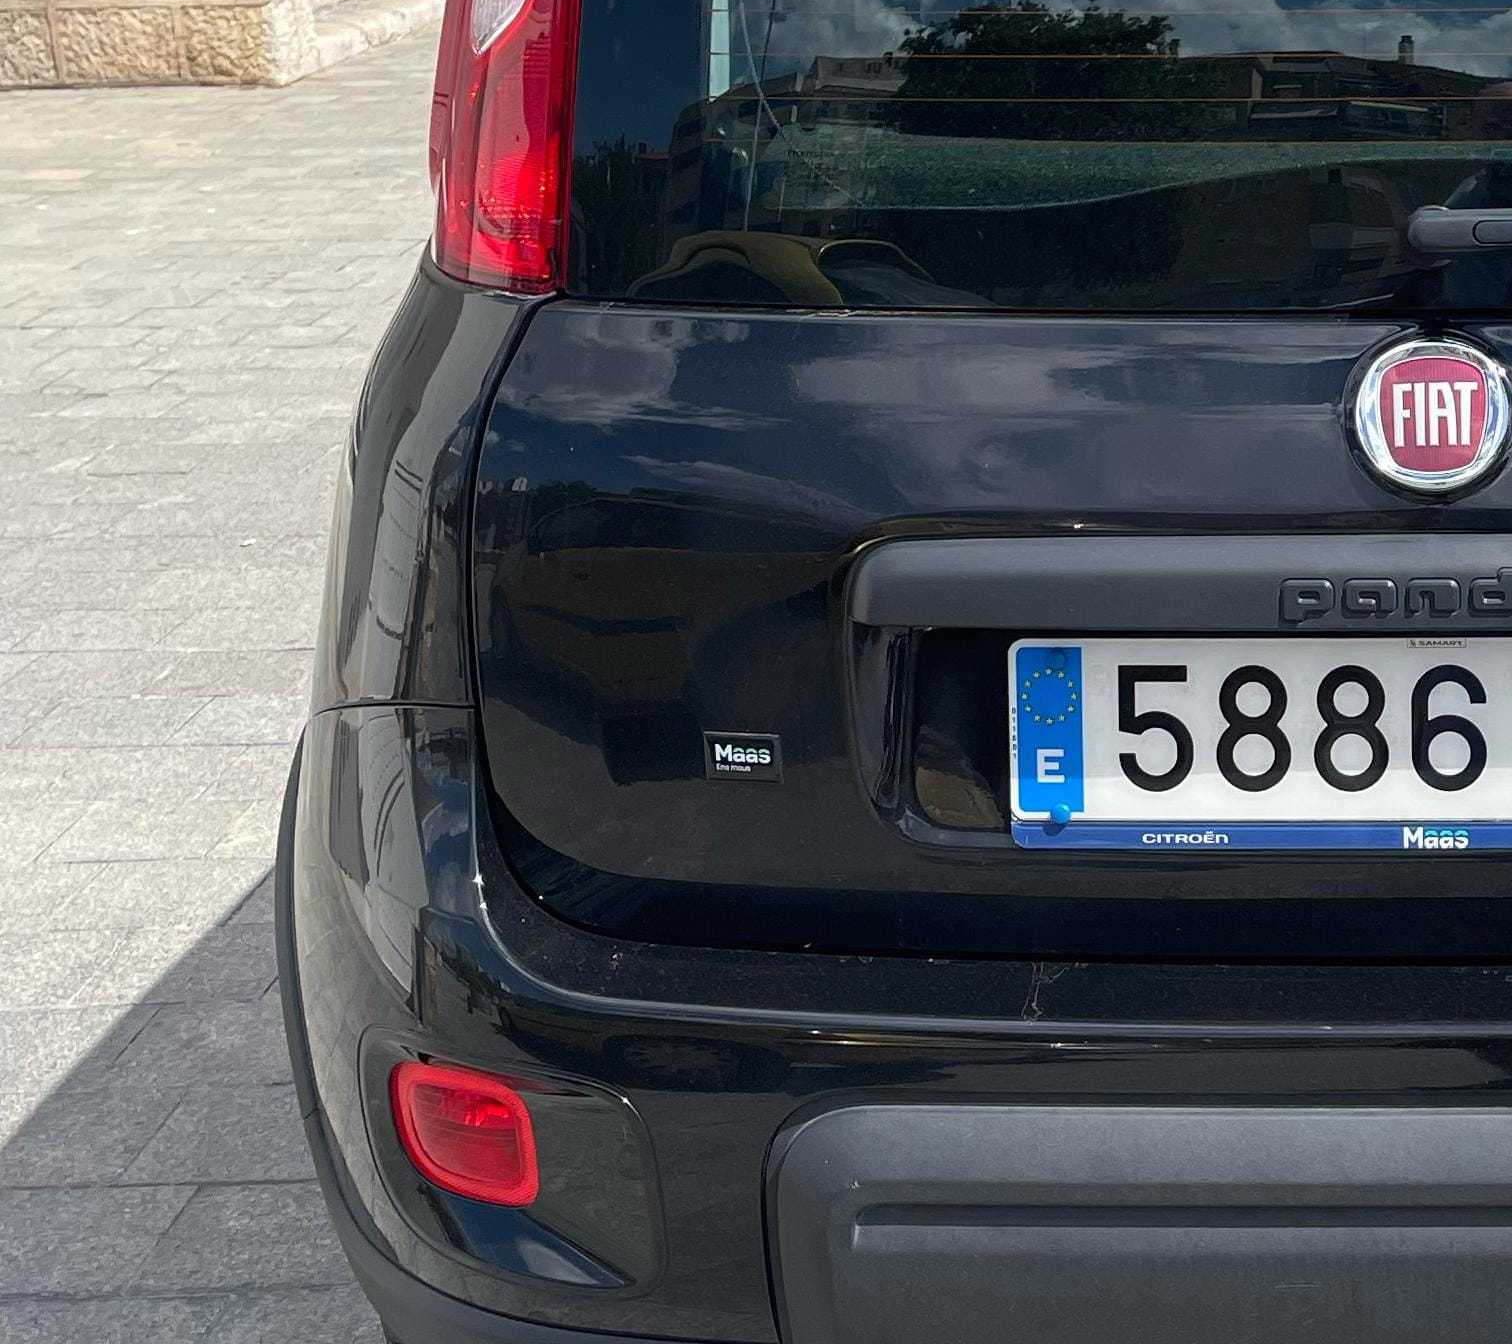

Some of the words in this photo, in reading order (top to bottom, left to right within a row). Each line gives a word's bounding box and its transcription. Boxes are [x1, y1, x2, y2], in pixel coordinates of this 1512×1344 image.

[1392, 381, 1478, 448] FIAT
[1117, 664, 1488, 792] 5886
[714, 743, 771, 764] Maas
[1036, 748, 1066, 784] E
[1402, 826, 1469, 849] Maas
